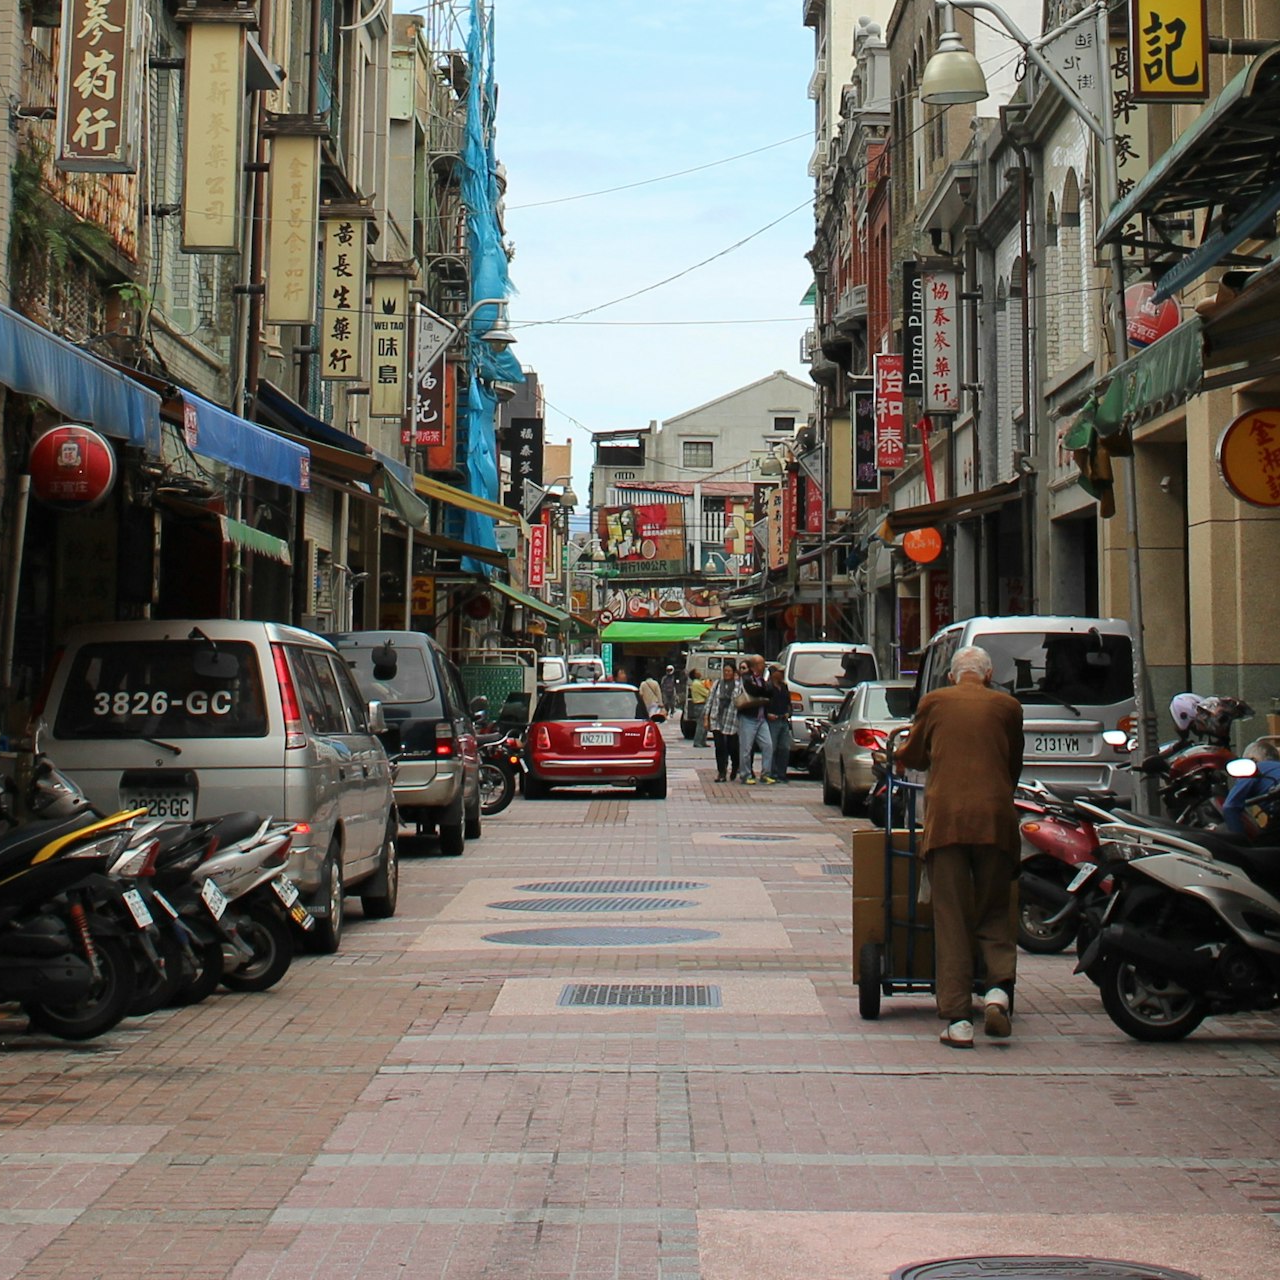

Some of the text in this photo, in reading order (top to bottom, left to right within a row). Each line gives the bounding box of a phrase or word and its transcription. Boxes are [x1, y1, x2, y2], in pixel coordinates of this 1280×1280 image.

[327, 221, 356, 373] 黃長生藥行
[374, 321, 404, 330] WEI TAO
[931, 281, 951, 402] 協泰蔘藥行
[377, 336, 398, 384] 味島
[92, 690, 233, 716] 3826-GC
